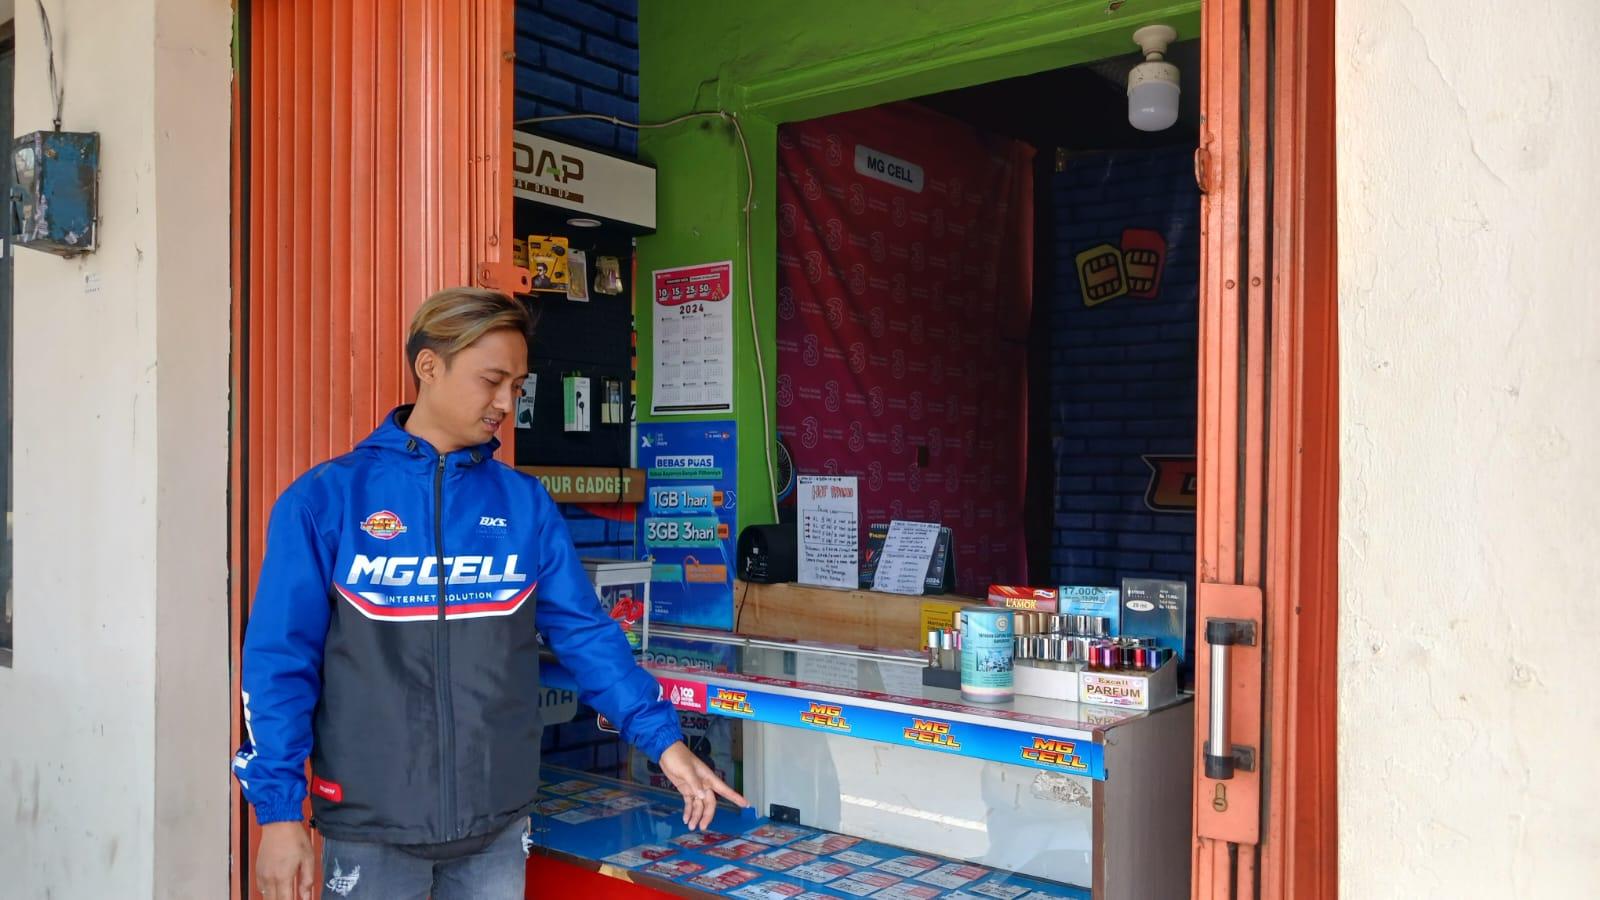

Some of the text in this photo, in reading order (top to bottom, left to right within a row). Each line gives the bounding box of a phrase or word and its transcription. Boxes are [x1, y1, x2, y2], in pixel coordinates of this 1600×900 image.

[867, 155, 913, 183] MG CELL
[679, 304, 704, 314] 2024
[657, 458, 712, 467] BEBAS PUAS
[536, 476, 631, 494] OUR GADGET
[653, 491, 678, 507] 1GB
[647, 522, 679, 540] 3GB
[385, 595, 436, 604] INTERNET
[717, 687, 748, 702] MG
[1086, 684, 1141, 698] PARFUM
[709, 698, 754, 713] CELL
[809, 702, 843, 717] MG
[800, 711, 850, 729] CELL
[913, 718, 950, 734] MG
[903, 728, 961, 748] CELL
[1033, 737, 1075, 754] MG
[1022, 747, 1088, 769] CELL
